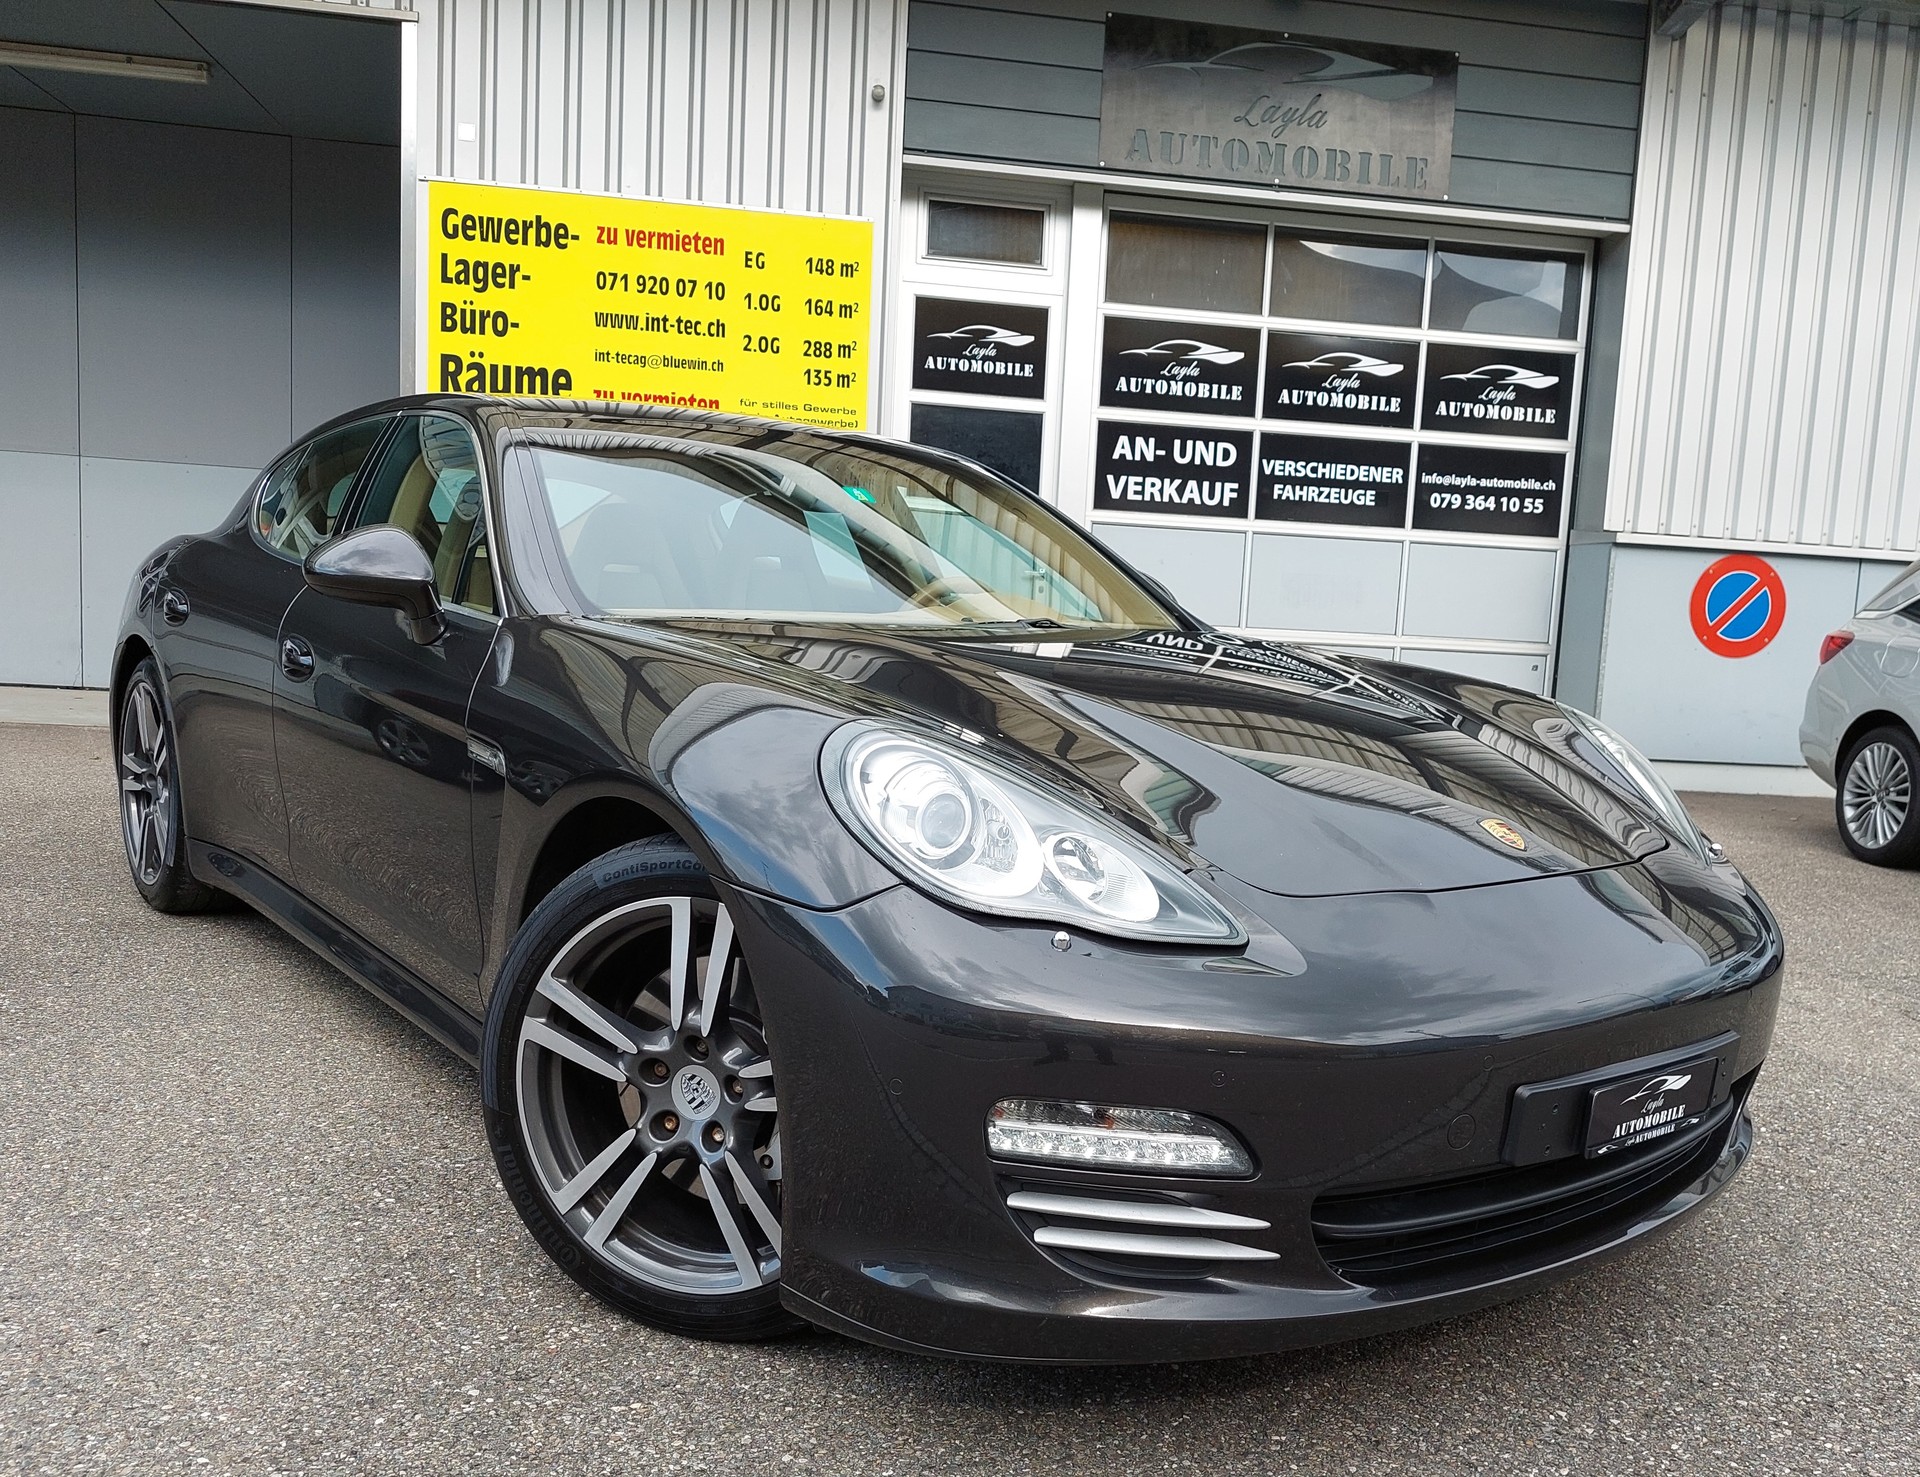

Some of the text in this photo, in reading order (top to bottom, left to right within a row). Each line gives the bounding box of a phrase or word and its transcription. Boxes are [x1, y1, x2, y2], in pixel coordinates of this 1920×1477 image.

[1234, 93, 1329, 139] Layla
[1124, 128, 1429, 191] AUTOMOBILE
[441, 207, 580, 250] Gewerbe-
[596, 225, 725, 256] zu vermieten
[441, 252, 531, 293] Lager-
[744, 251, 765, 270] EG
[805, 257, 835, 276] 148
[596, 270, 726, 301] 071 920 07 10
[441, 299, 520, 338] Büro-
[804, 298, 834, 317] 164
[594, 311, 726, 338] www.int-tec.ch
[594, 349, 724, 373] int-tecag@bluewin.ch
[803, 339, 833, 359] 288
[962, 342, 997, 360] Layla
[440, 350, 573, 396] Räume
[803, 368, 832, 387] 135
[924, 355, 1034, 378] AUTOMOBILE
[1160, 360, 1200, 380] Layla
[1115, 376, 1242, 401] AUTOMOBILE
[1321, 373, 1361, 392] Layla
[1478, 385, 1516, 404] Layla
[740, 398, 857, 416] für stilles Gewerbe
[1277, 388, 1402, 413] AUTOMOBILE
[1435, 400, 1557, 424] AUTOMOBILE
[1112, 435, 1238, 467] AN- UND
[1261, 458, 1404, 484] VERSCHIEDENER
[1421, 472, 1556, 492] info@layla-automobile.ch
[1106, 474, 1239, 507] VERKAUF
[1273, 483, 1376, 506] FAHRZEUGE
[1430, 492, 1544, 514] 079 364 10 55
[1640, 1092, 1665, 1115] Layla
[1612, 1104, 1686, 1139] AUTOMOBILE
[1634, 1123, 1676, 1144] AUTOMOBILE
